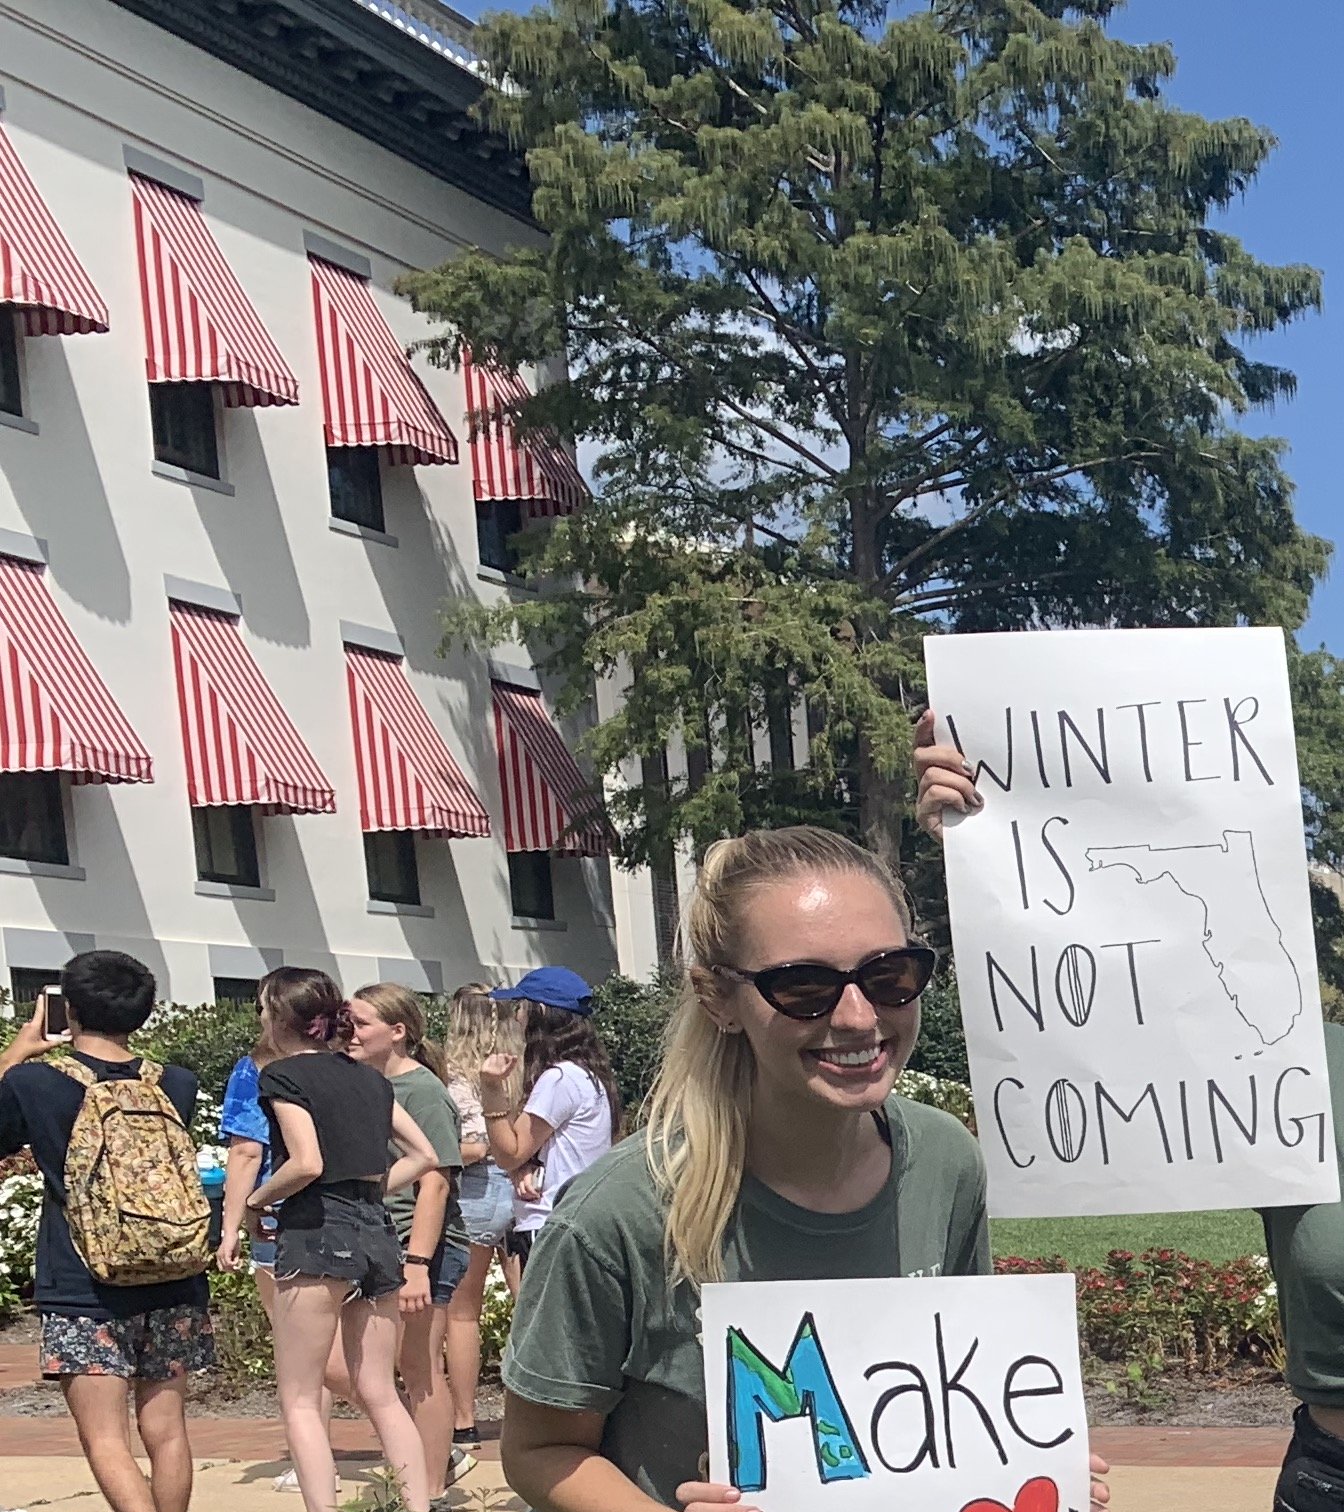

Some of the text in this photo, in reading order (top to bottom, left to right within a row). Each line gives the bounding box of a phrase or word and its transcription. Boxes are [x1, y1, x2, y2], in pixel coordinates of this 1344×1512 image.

[946, 696, 1274, 793] WINTER
[1011, 816, 1075, 916] IS
[986, 939, 1161, 1032] NOT
[993, 1067, 1325, 1168] COMING
[726, 1311, 1074, 1492] Make
